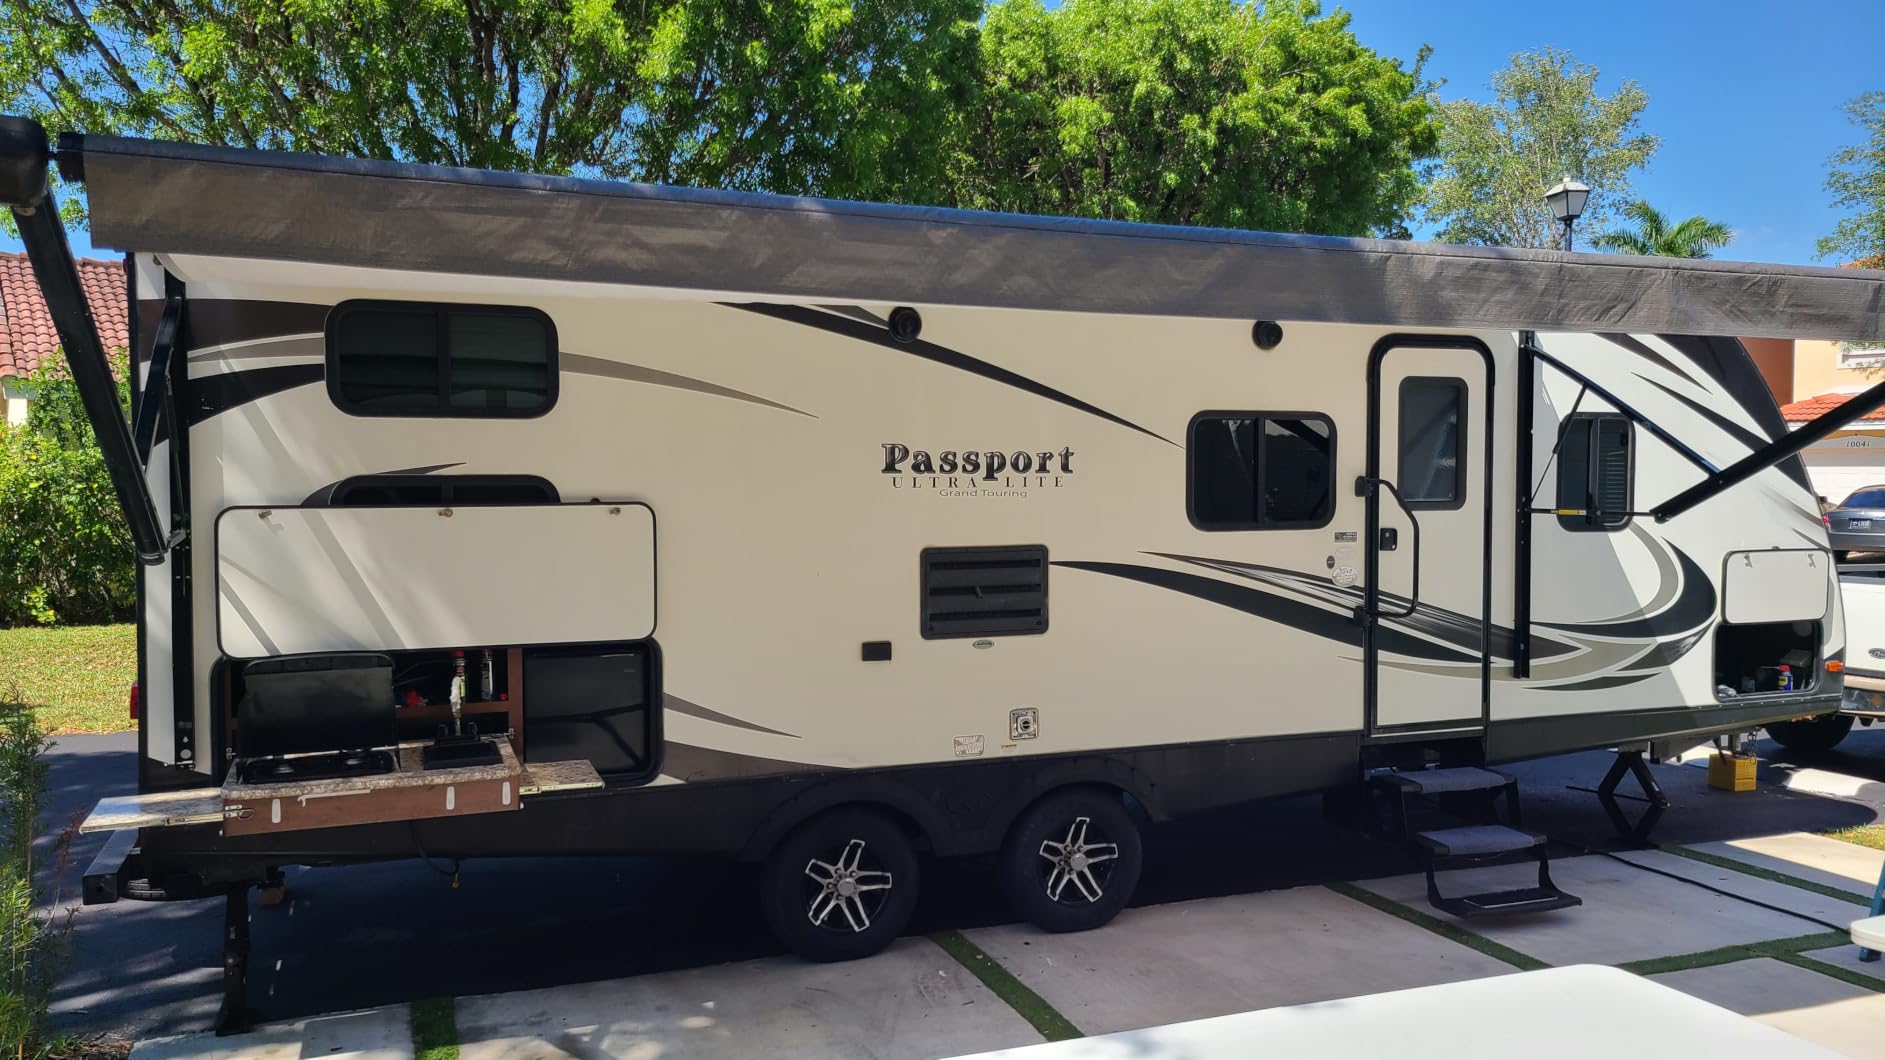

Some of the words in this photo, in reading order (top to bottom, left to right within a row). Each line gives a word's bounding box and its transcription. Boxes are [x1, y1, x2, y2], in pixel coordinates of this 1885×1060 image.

[1846, 440, 1870, 448] 10041
[881, 443, 1075, 482] Passport
[892, 476, 978, 489] ULTRA
[1005, 476, 1064, 488] LITE
[939, 488, 978, 497] Grand
[981, 489, 1028, 498] Touring
